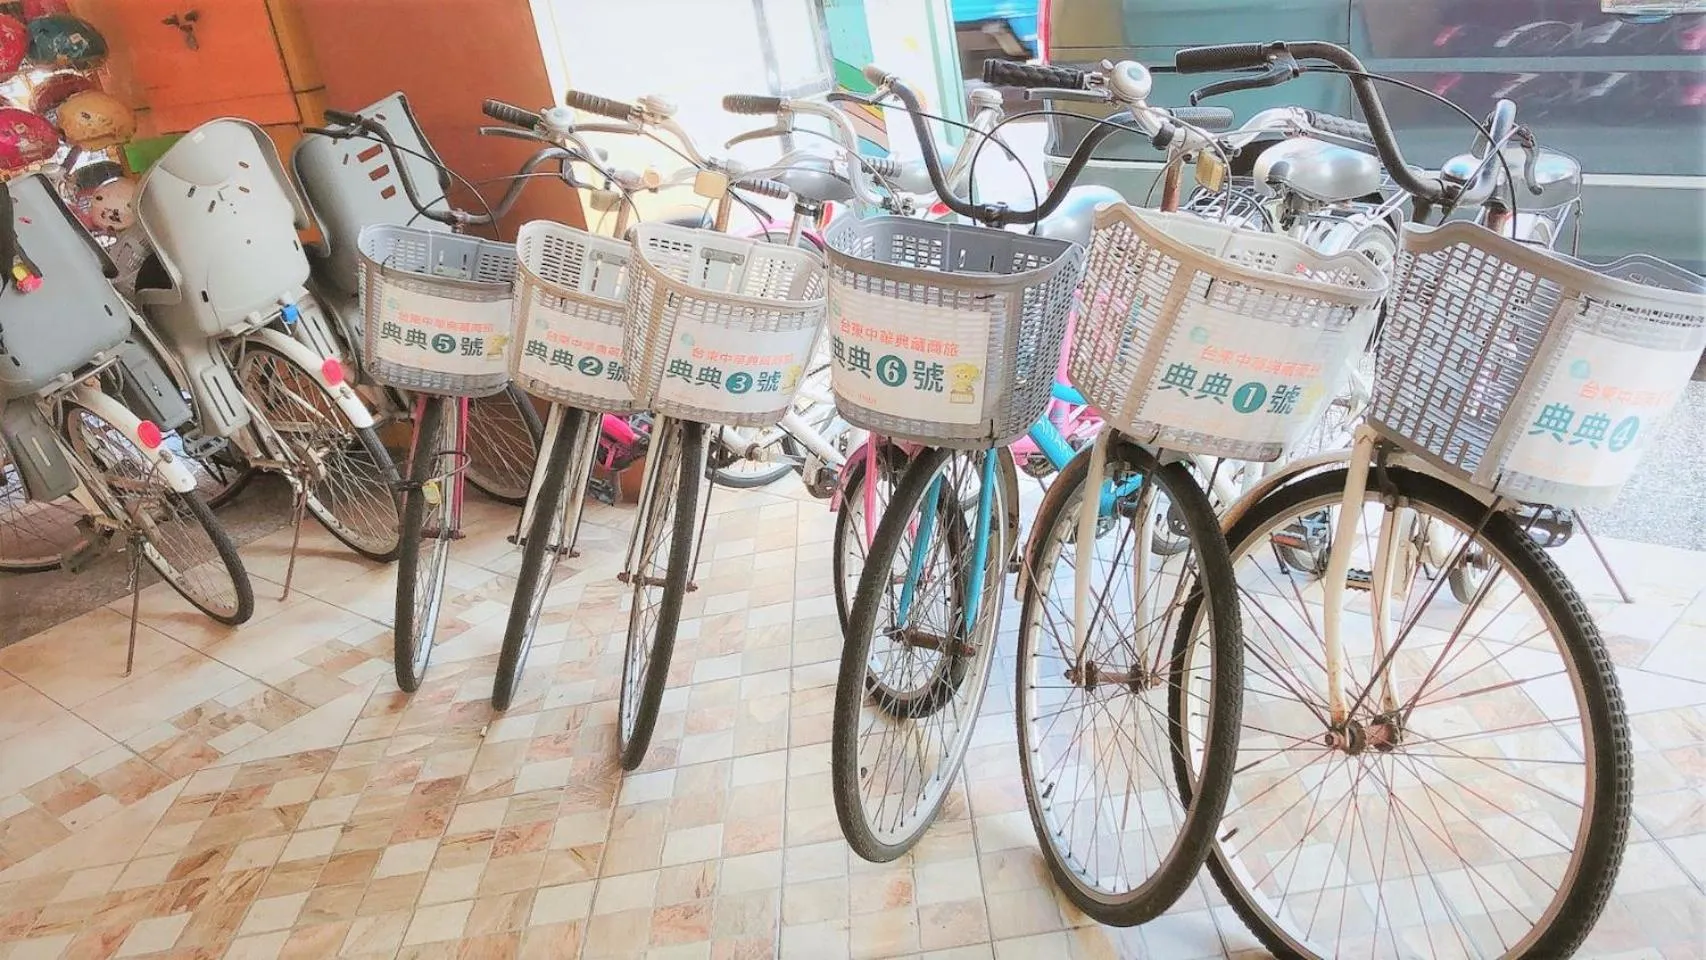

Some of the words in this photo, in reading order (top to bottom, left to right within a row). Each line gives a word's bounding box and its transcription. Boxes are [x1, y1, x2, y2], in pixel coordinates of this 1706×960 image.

[380, 321, 485, 357] 典典5號
[839, 317, 961, 357] 台東中華典藏商旅
[525, 339, 630, 382] 典典2號
[666, 358, 781, 395] 典典3號
[832, 334, 945, 393] 典典6號
[1158, 361, 1302, 416] 典典1號
[1527, 402, 1640, 453] 典典4
